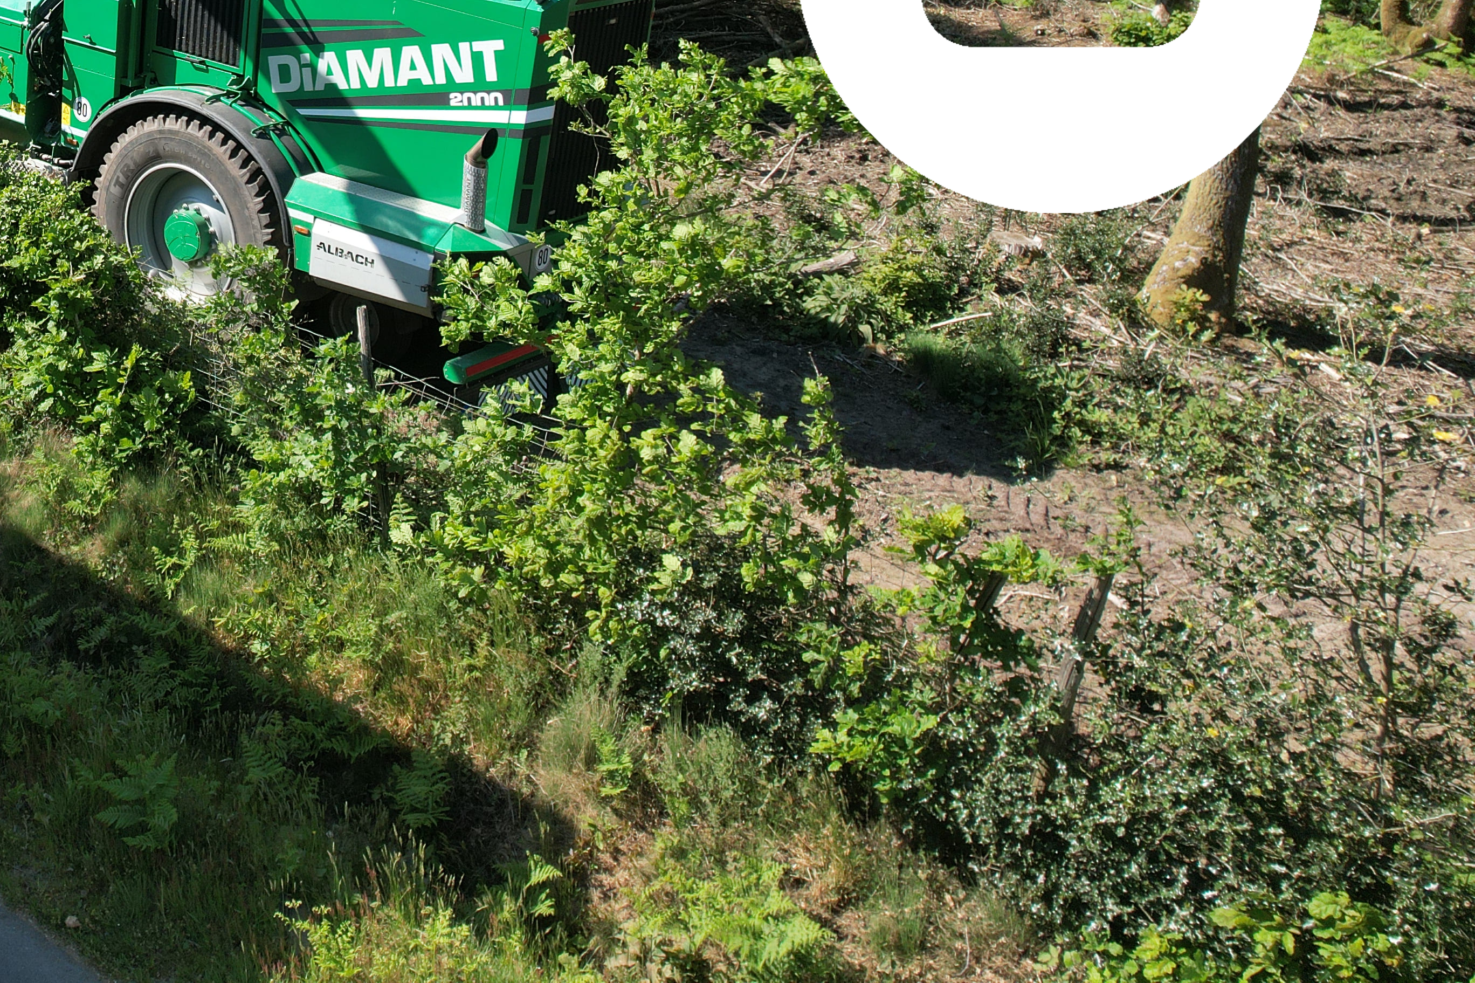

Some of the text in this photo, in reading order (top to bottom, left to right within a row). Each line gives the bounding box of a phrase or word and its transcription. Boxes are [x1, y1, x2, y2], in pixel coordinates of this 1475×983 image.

[76, 101, 88, 118] 80
[316, 241, 375, 269] ALBACH
[537, 247, 549, 267] 80
